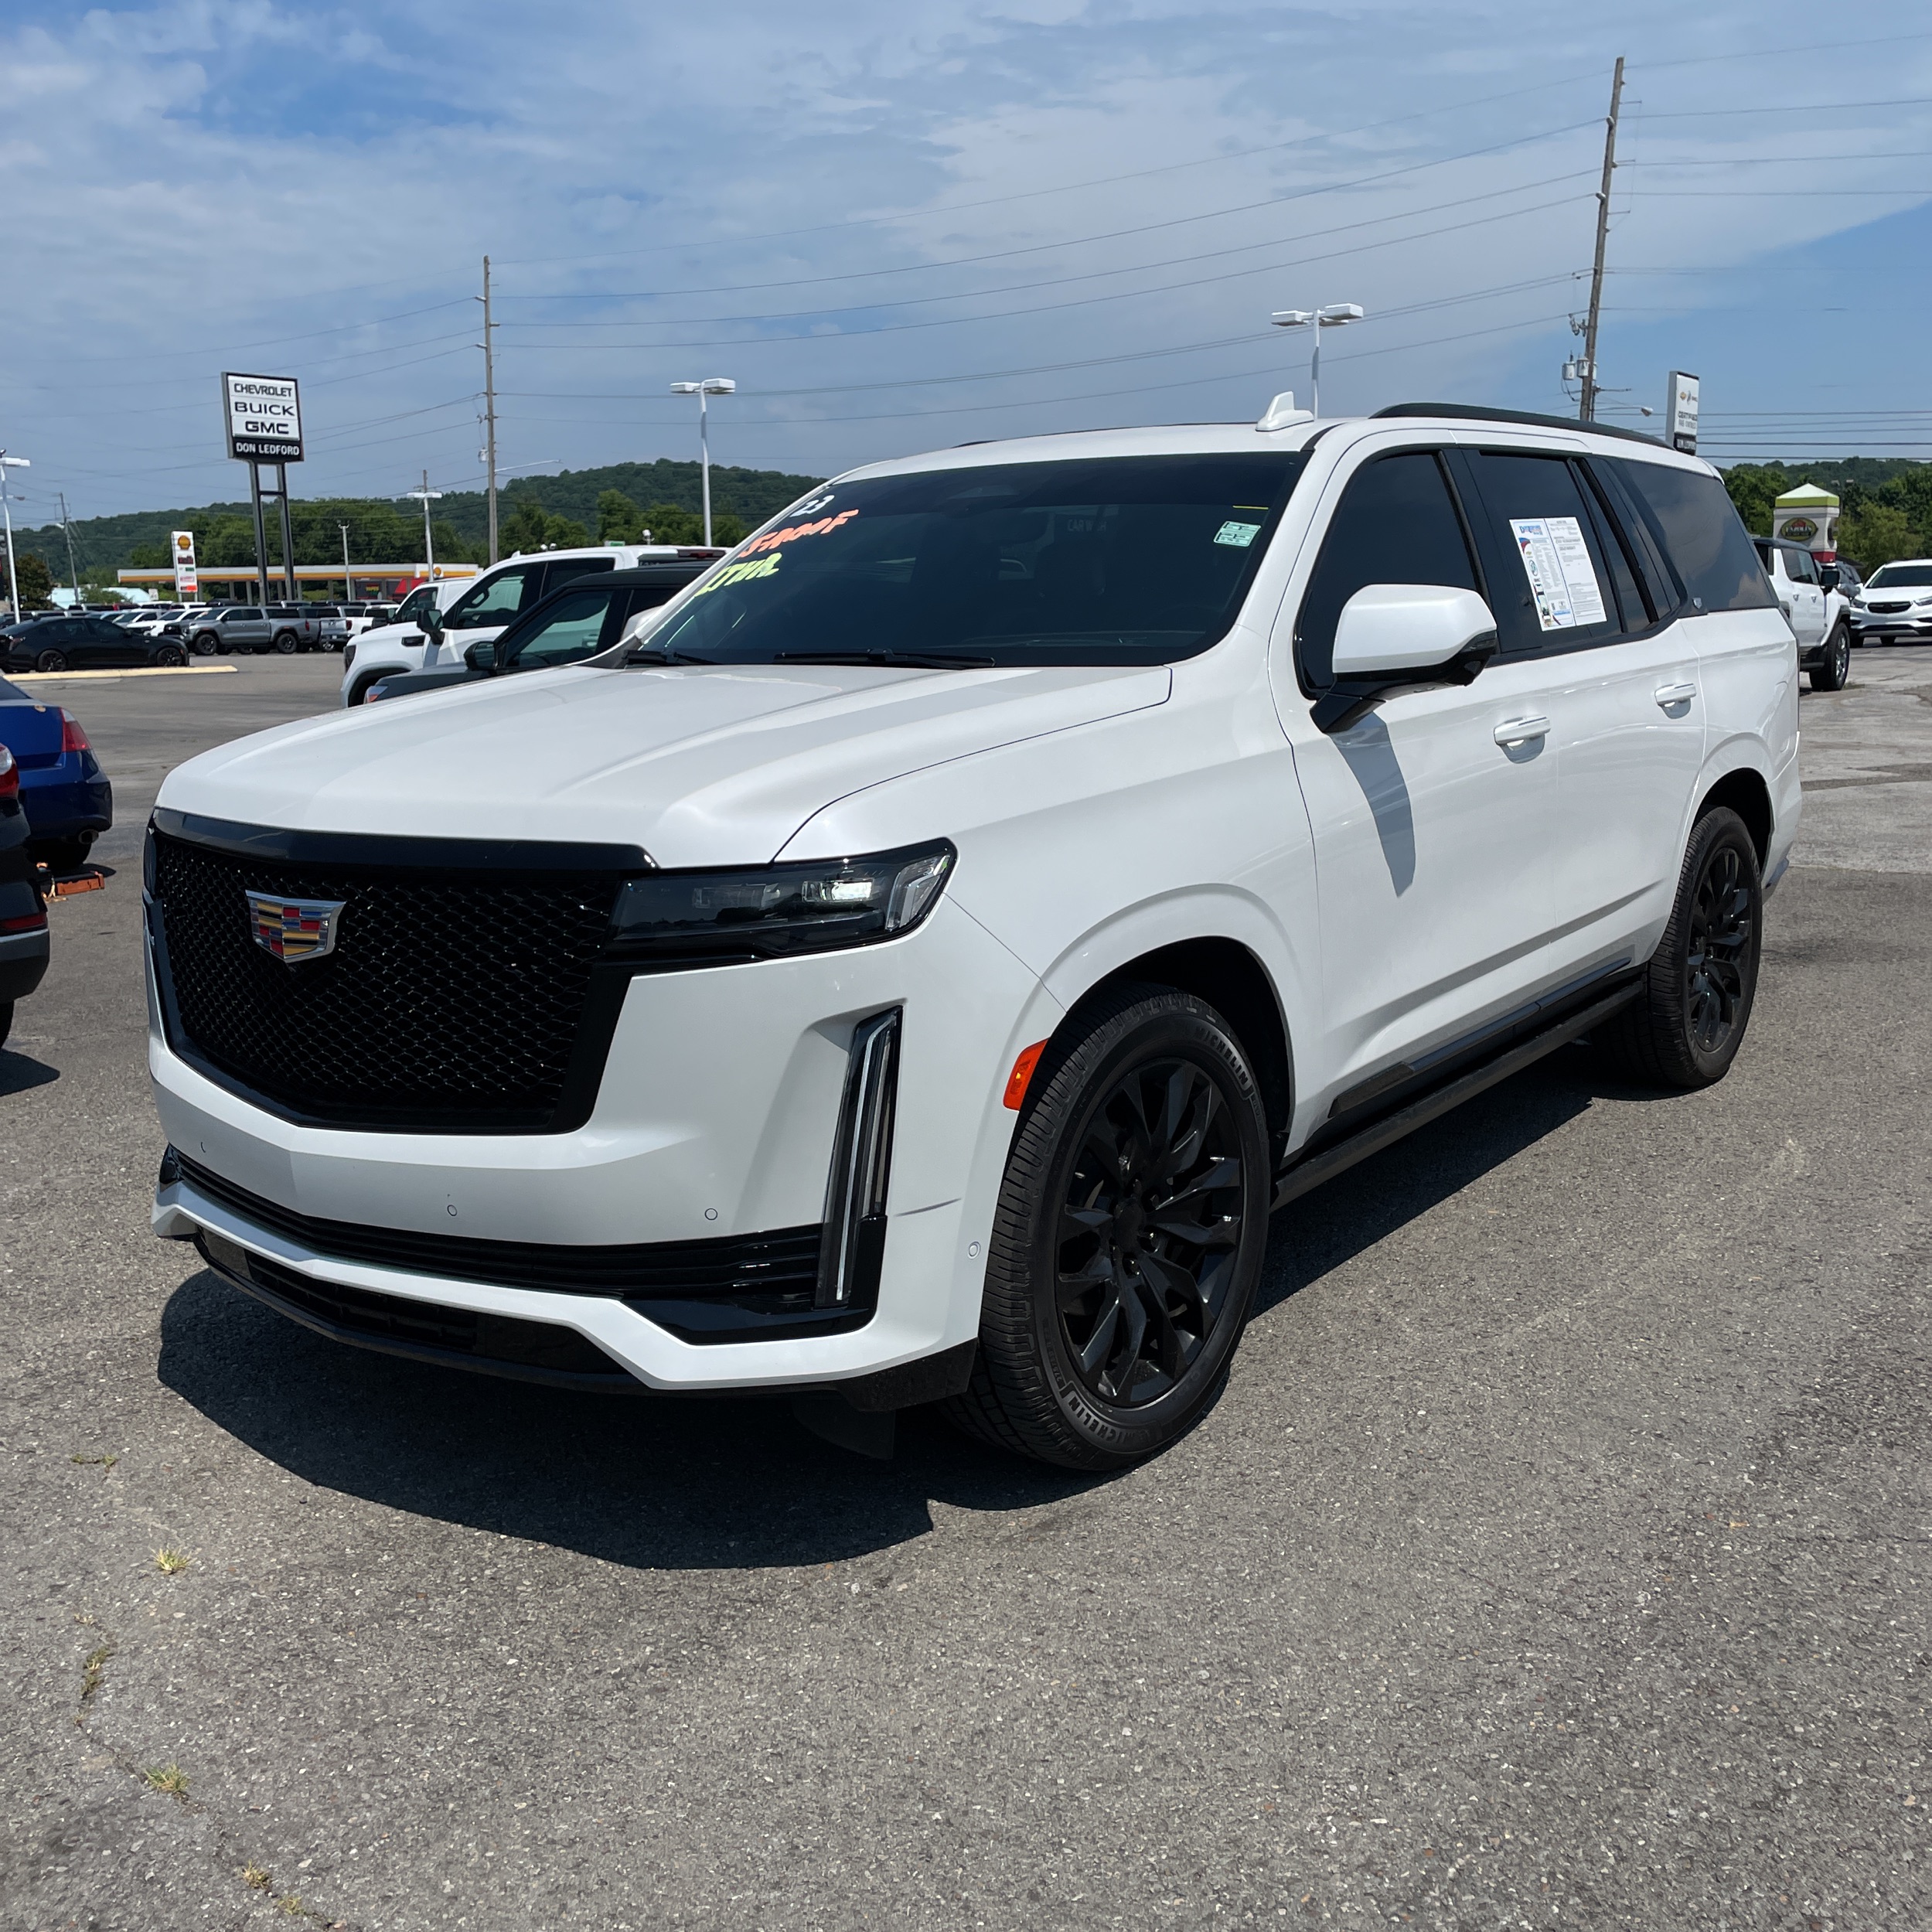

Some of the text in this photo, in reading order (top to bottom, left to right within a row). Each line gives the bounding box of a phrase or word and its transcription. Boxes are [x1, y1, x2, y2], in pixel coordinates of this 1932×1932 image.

[233, 383, 292, 397] CHEVROLET
[234, 401, 295, 417] BUICK
[245, 421, 289, 434] GMC
[236, 442, 300, 455] DON LEDFORD
[789, 494, 835, 517] 23
